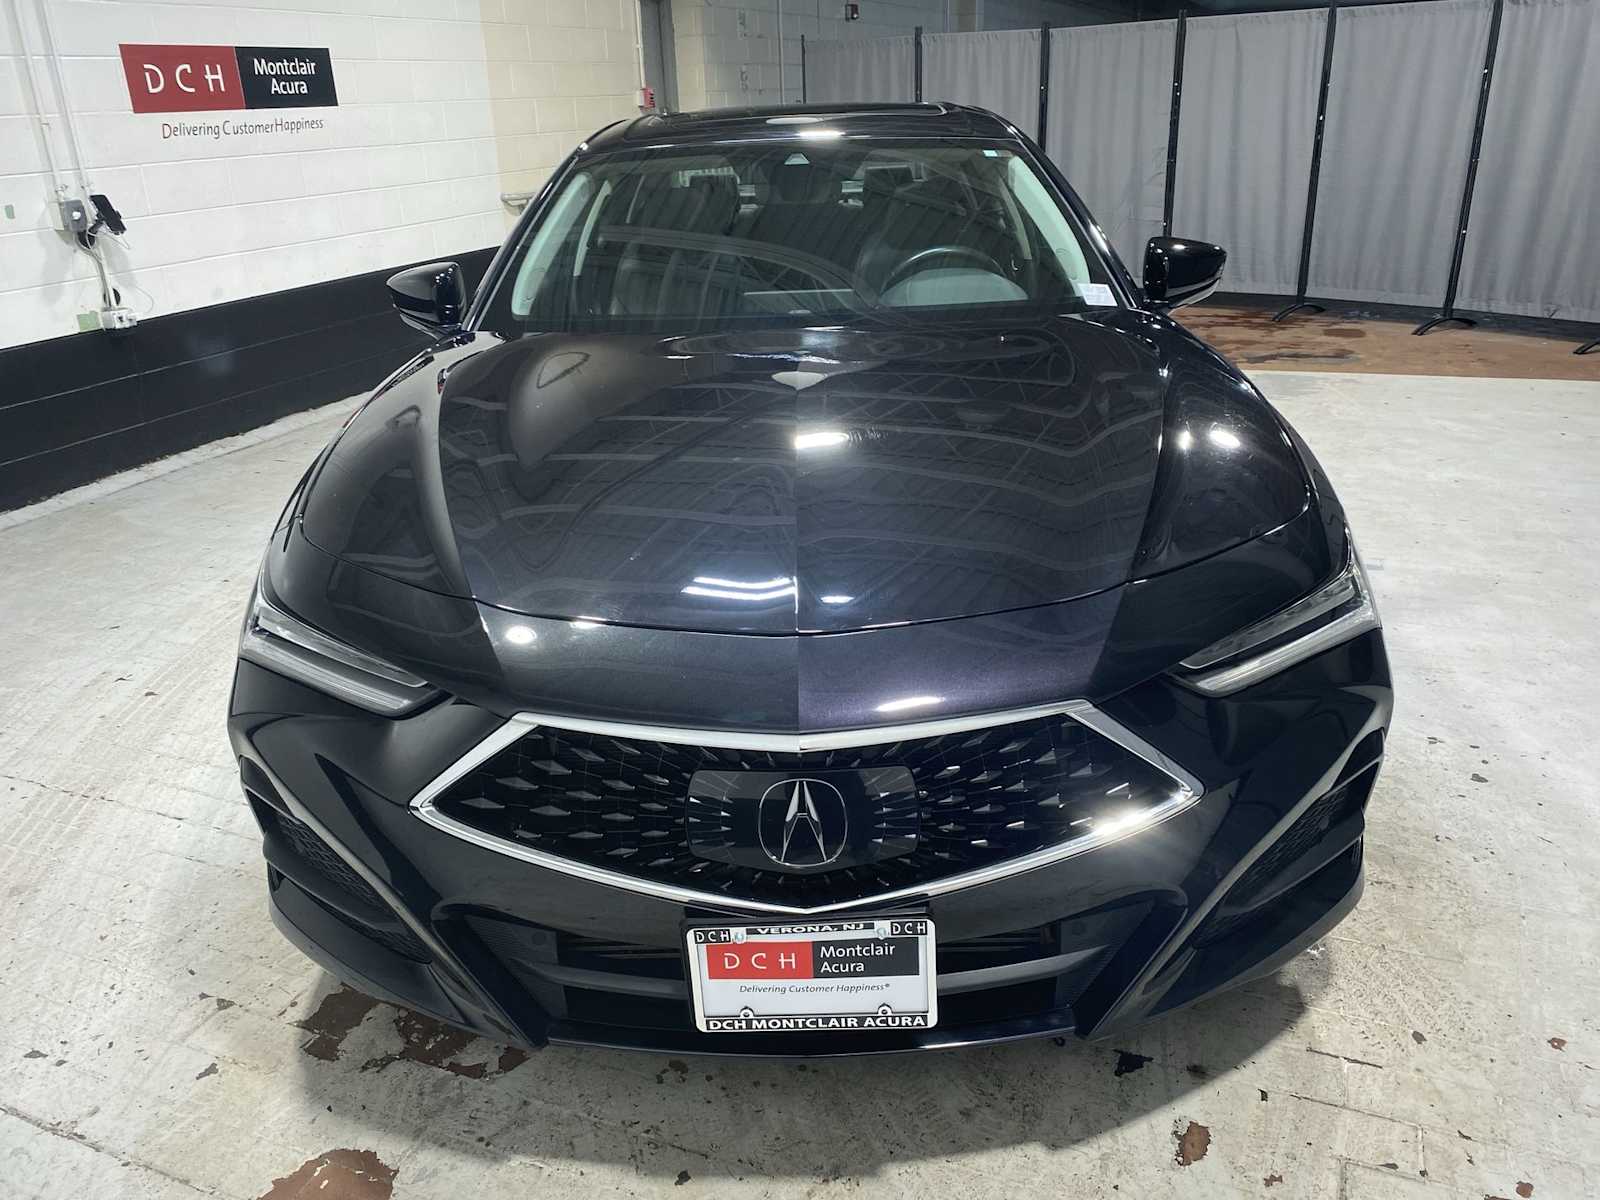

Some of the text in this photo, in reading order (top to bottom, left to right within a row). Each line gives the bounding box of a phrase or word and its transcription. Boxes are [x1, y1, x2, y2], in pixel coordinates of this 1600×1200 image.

[253, 58, 316, 76] Montclair
[143, 64, 225, 93] DCH
[271, 78, 308, 94] Acura
[162, 123, 220, 140] Delivering
[892, 922, 926, 935] DCH
[696, 930, 730, 943] DCH
[820, 943, 895, 958] Montclair
[724, 952, 796, 970] DCH
[820, 961, 865, 973] Acura
[739, 985, 787, 995] Delivering
[788, 985, 834, 993] Customer
[709, 1016, 926, 1030] DCH MONTCLAIR ACURA
